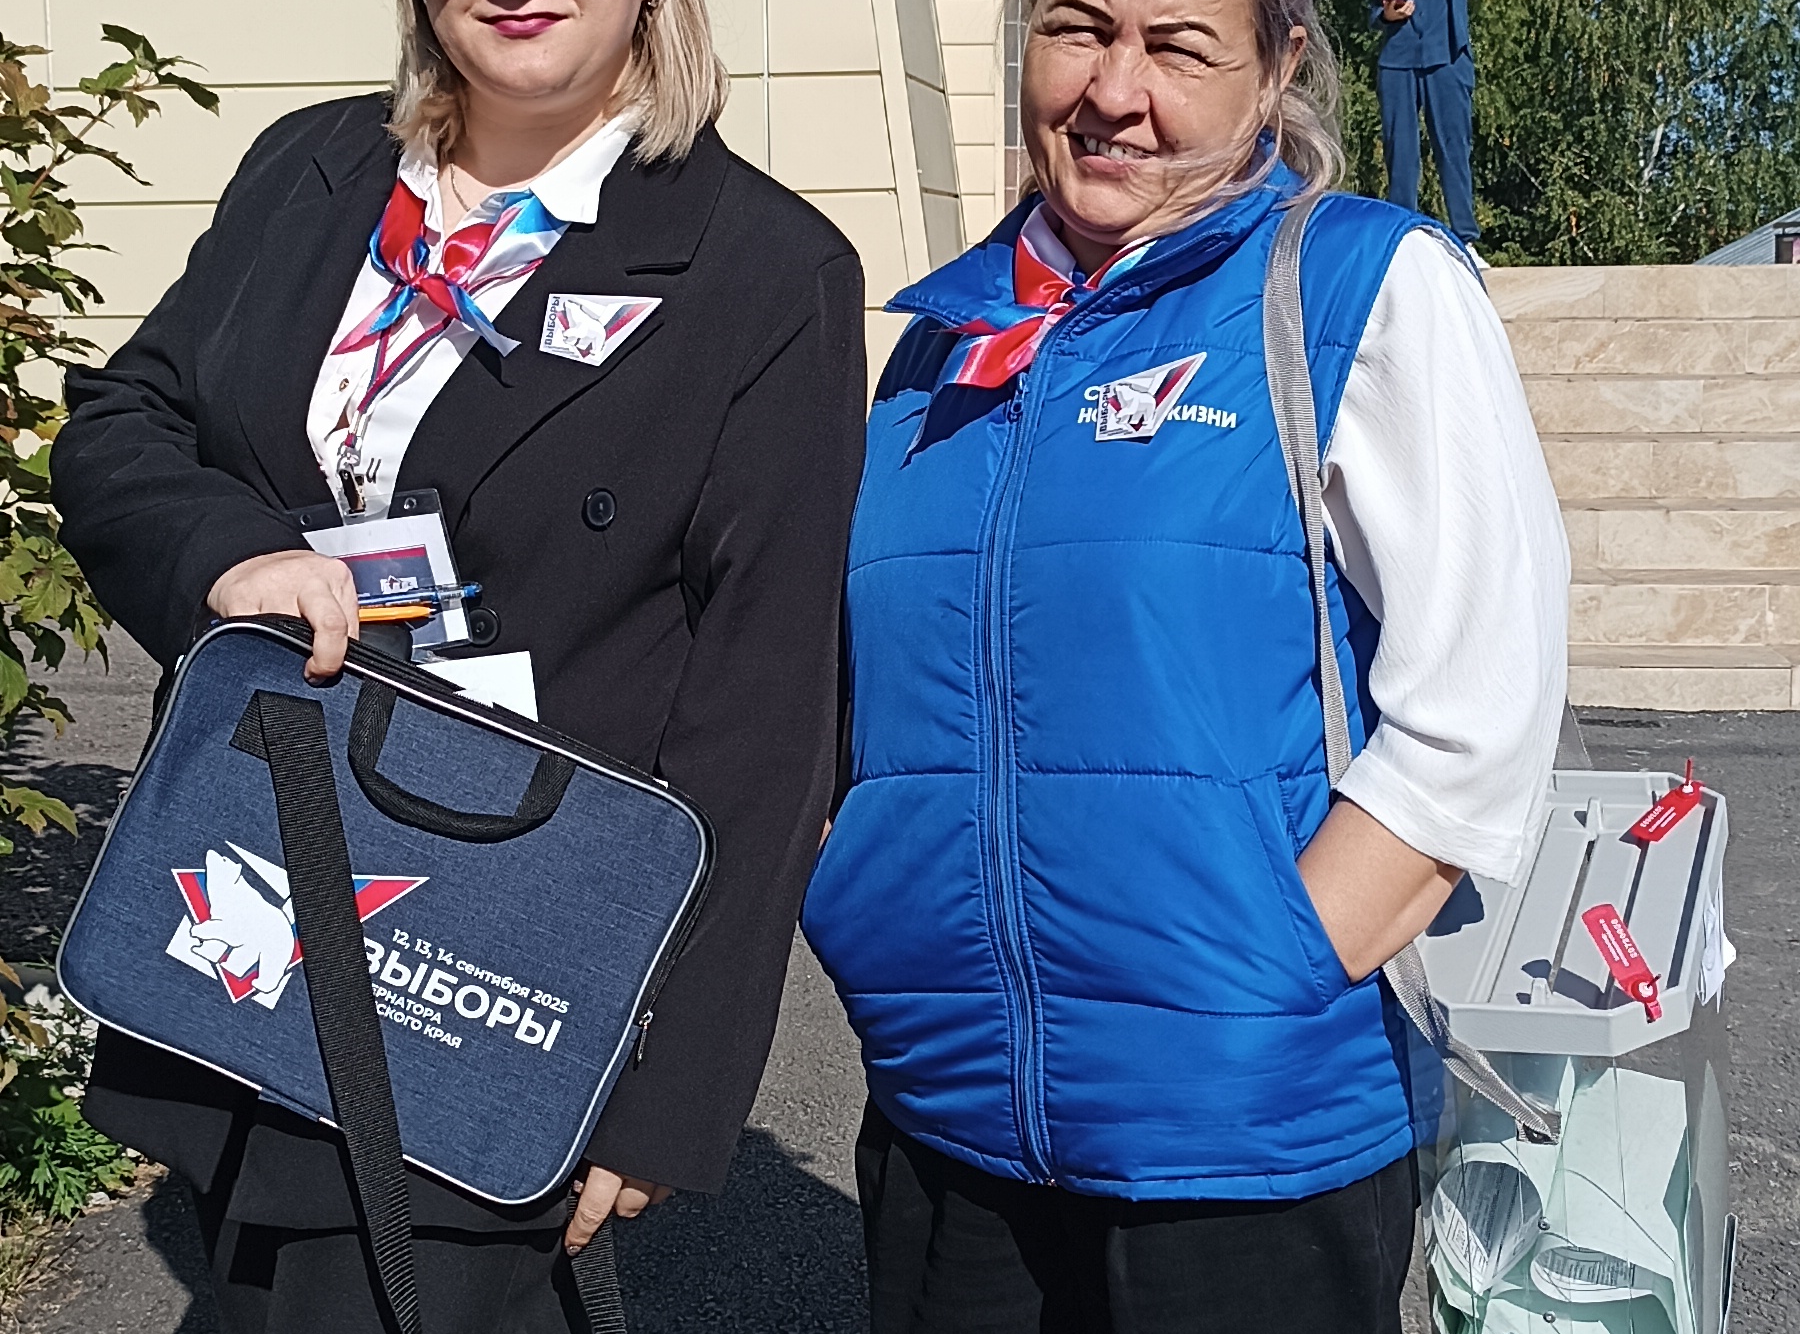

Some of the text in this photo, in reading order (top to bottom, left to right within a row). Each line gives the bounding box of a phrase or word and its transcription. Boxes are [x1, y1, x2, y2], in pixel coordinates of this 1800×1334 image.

[391, 928, 571, 1014] 12, 13, 14 сентября 2025
[371, 982, 443, 1025] РНАТОРА
[375, 1000, 463, 1049] СКОГО КРАЯ
